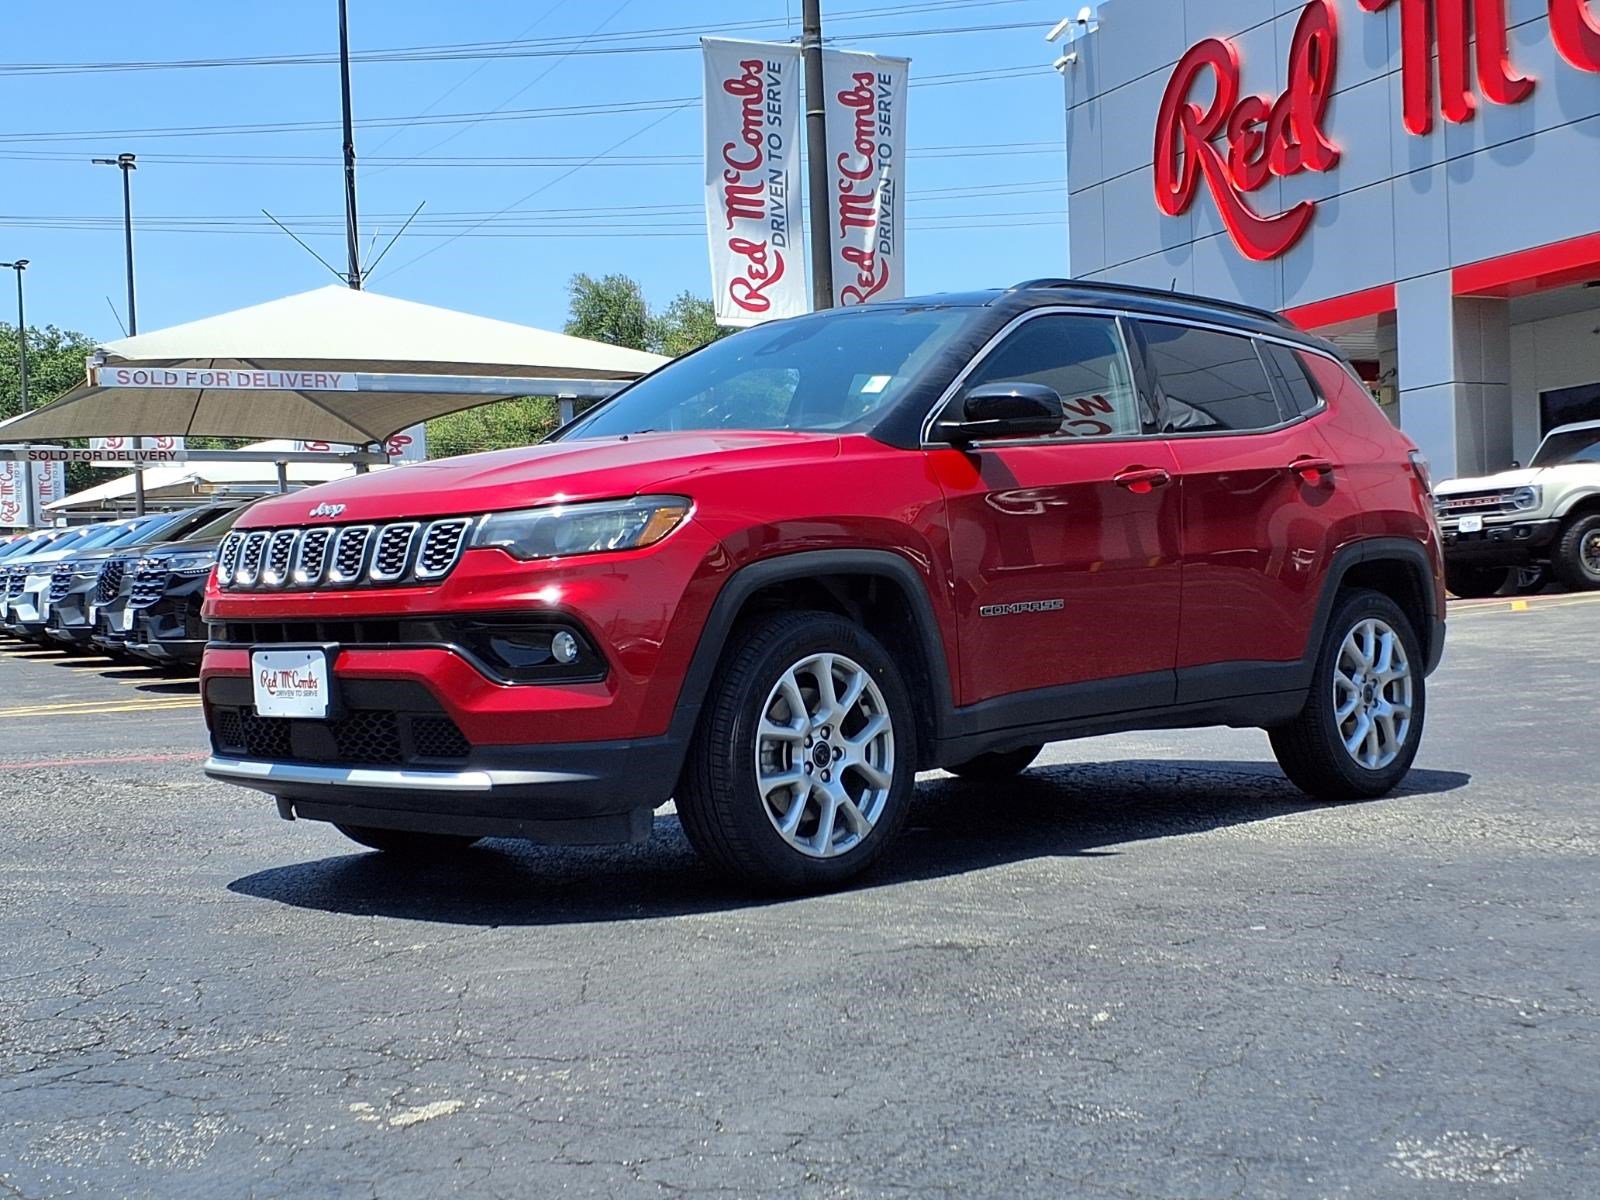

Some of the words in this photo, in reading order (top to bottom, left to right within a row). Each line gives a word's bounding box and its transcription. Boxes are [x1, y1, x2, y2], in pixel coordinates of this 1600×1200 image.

[766, 60, 782, 128] SERVE
[877, 72, 892, 137] SERVE
[722, 59, 767, 230] McCombs
[767, 132, 783, 161] TO
[837, 71, 877, 239] McCombs
[877, 142, 893, 172] TO
[1153, 0, 1341, 262] Red
[768, 168, 787, 248] DRIVEN
[878, 177, 893, 256] DRIVEN
[728, 237, 785, 312] Red
[840, 245, 889, 306] Red
[116, 369, 179, 386] SOLD
[185, 371, 231, 388] FOR
[237, 372, 342, 389] DELIVERY
[28, 450, 69, 461] SOLD
[73, 450, 102, 461] FOR
[107, 450, 176, 461] DELIVERY
[0, 500, 20, 522] Red
[309, 502, 346, 519] Jeep
[980, 599, 1064, 616] COMPASS
[260, 669, 277, 695] Red
[278, 670, 319, 689] McCombs
